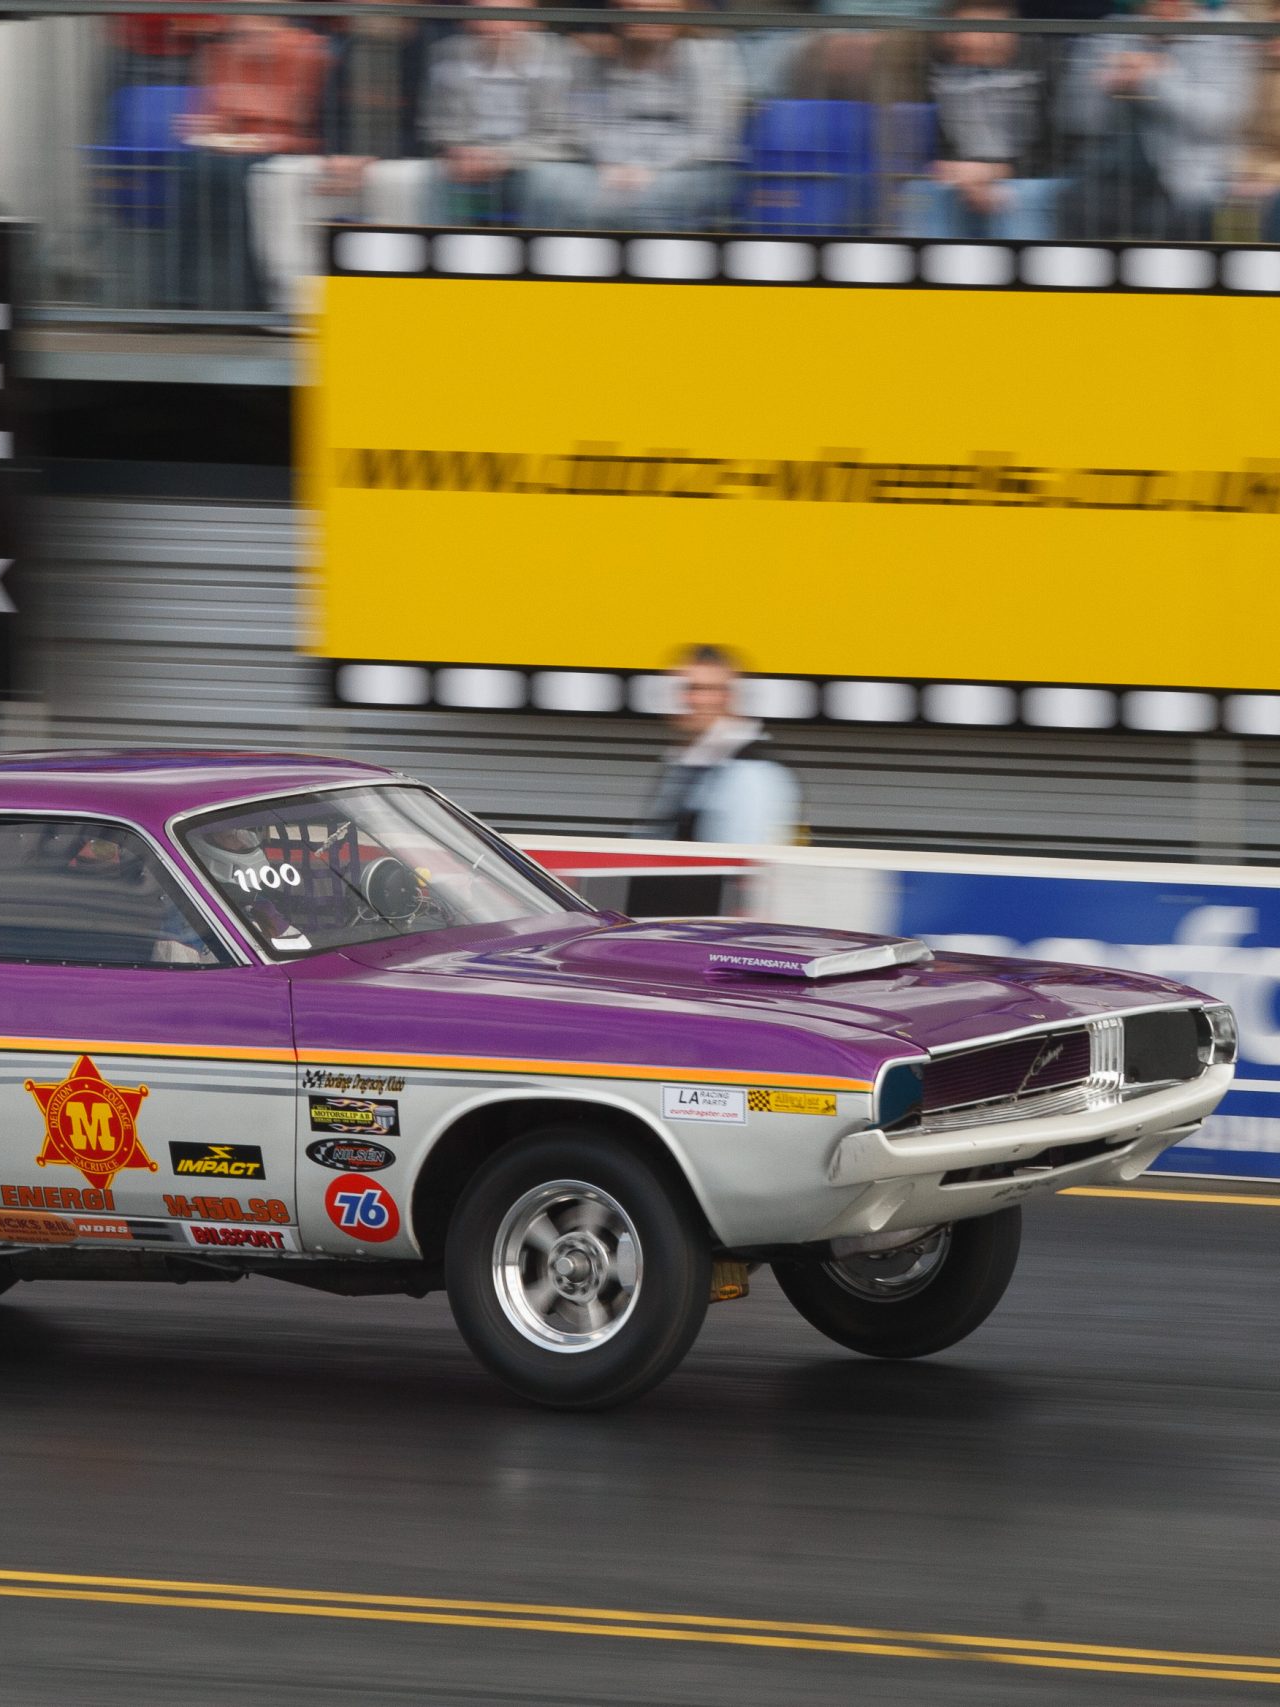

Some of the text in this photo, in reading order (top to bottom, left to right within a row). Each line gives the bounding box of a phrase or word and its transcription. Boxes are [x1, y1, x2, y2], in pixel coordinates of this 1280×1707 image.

[233, 862, 301, 893] 1100
[49, 1084, 72, 1129] DEVOTION
[103, 1087, 132, 1130] COURAGE
[678, 1090, 699, 1105] LA
[66, 1101, 116, 1152] M
[73, 1155, 119, 1172] SACRIFICE
[177, 1159, 260, 1175] IMPACT
[0, 1184, 116, 1211] ENERGI
[334, 1189, 389, 1229] 76
[78, 1223, 128, 1234] NDRS
[189, 1225, 286, 1250] BILSPORT
